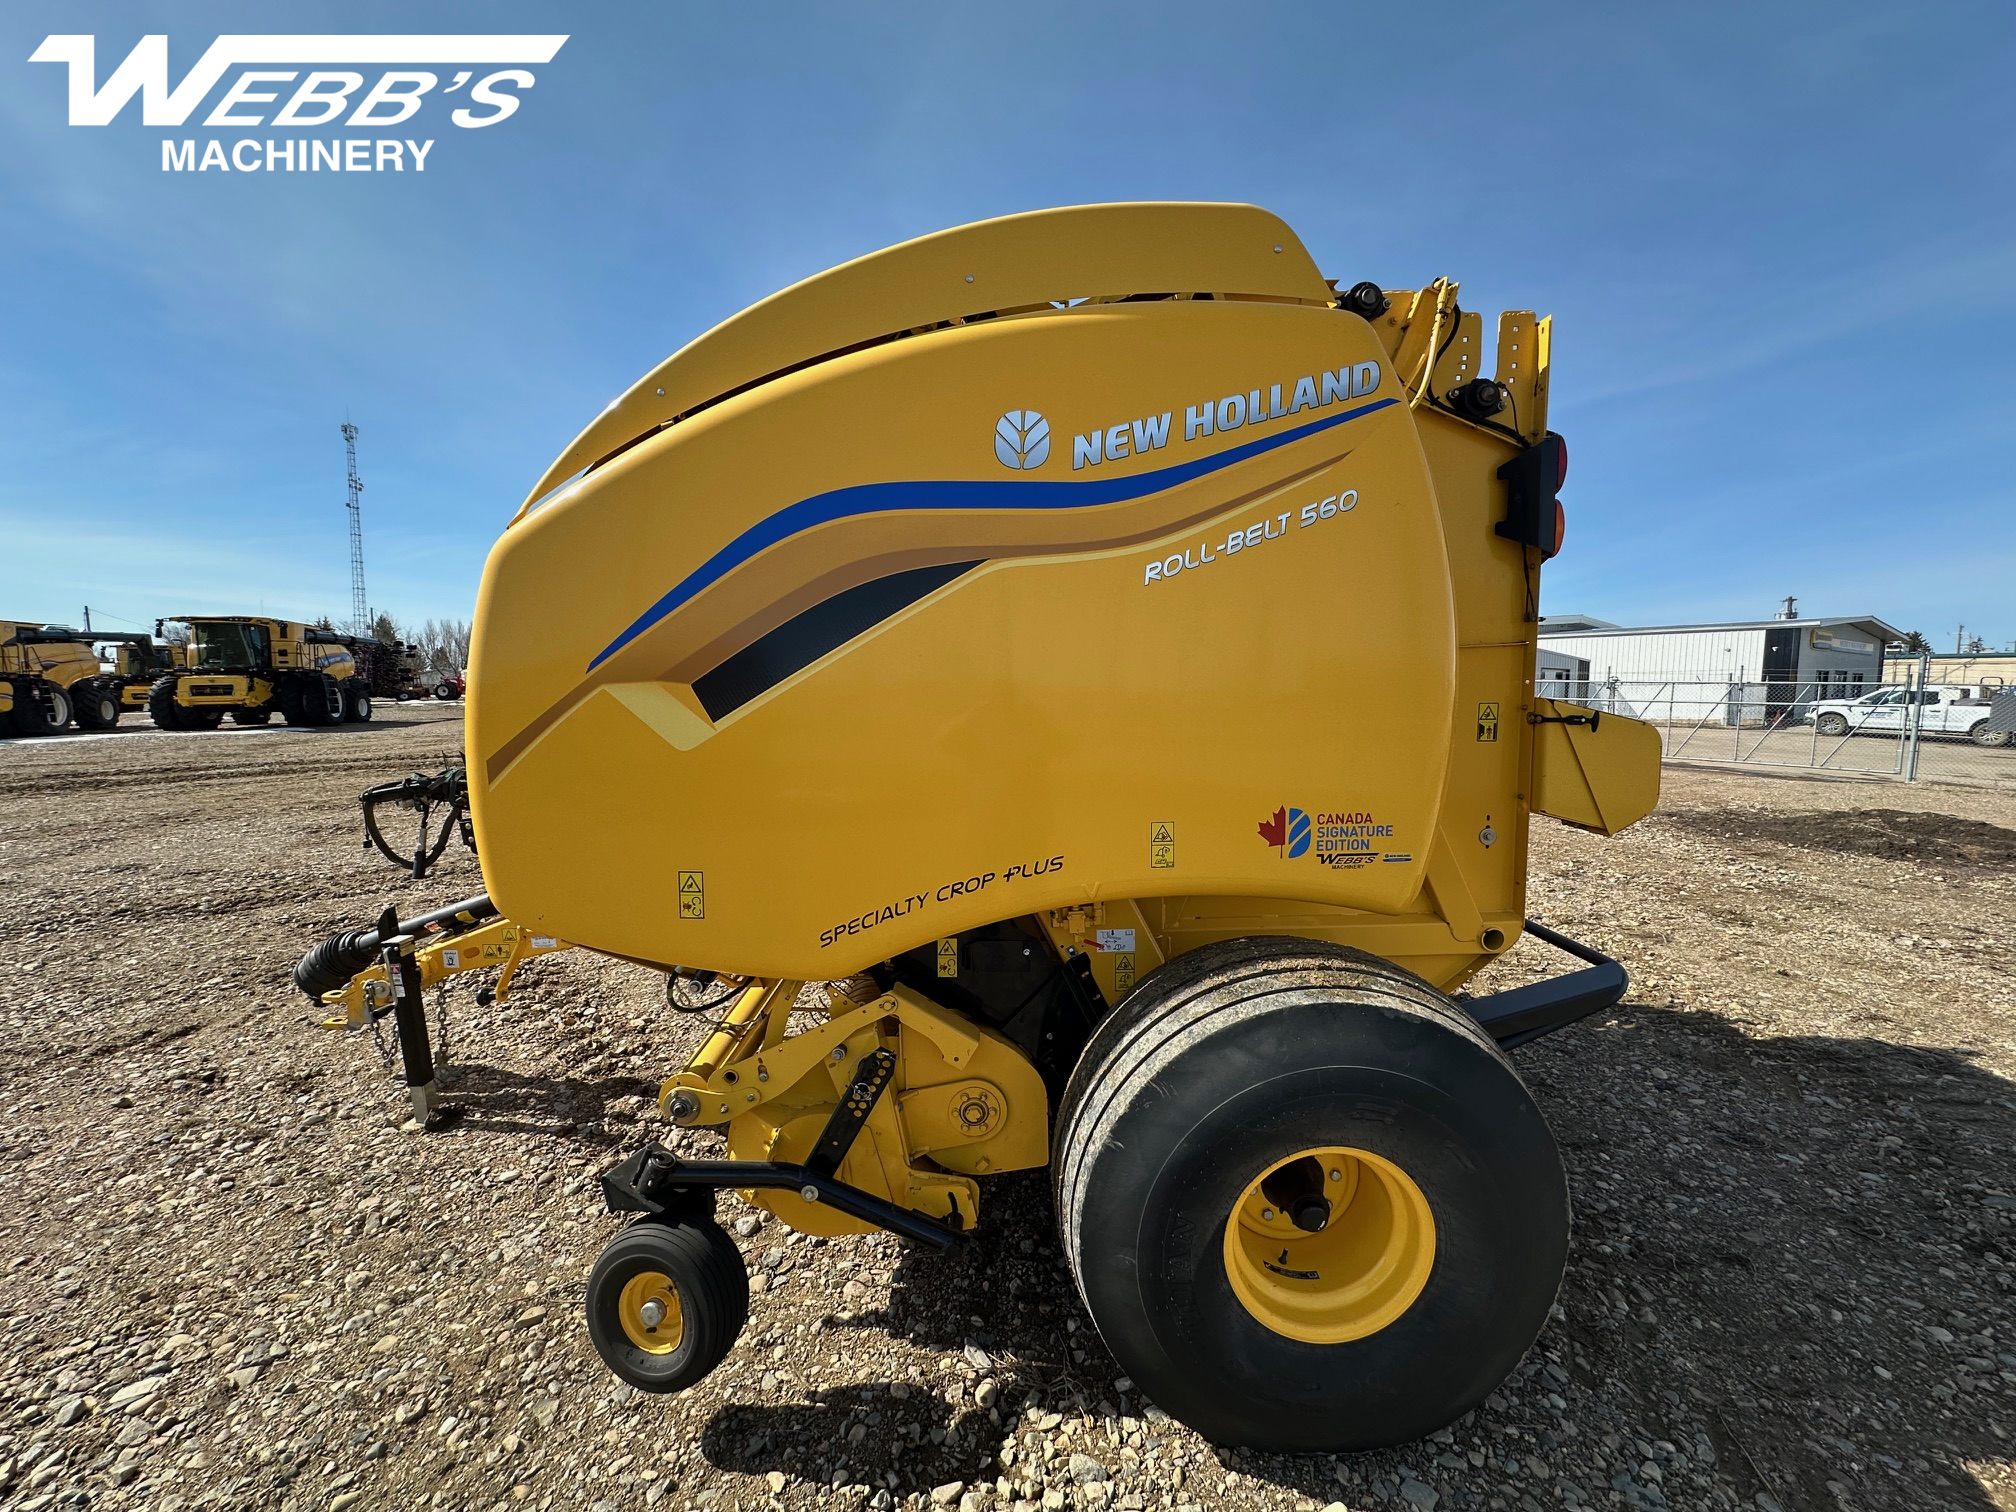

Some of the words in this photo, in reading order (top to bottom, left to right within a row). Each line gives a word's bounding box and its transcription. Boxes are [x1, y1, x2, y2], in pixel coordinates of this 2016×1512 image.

[1073, 411, 1172, 470] NEW
[1184, 360, 1381, 441] HOLLAND
[1144, 511, 1292, 586] ROLL-BELT
[1300, 489, 1359, 528] 560
[1317, 812, 1373, 825] CANADA
[1317, 825, 1393, 838] SIGNATURE
[1316, 838, 1370, 852] EDITION
[1316, 852, 1380, 865] WEBB'S
[819, 891, 930, 949] SPECIALTY
[936, 872, 996, 902] CROP
